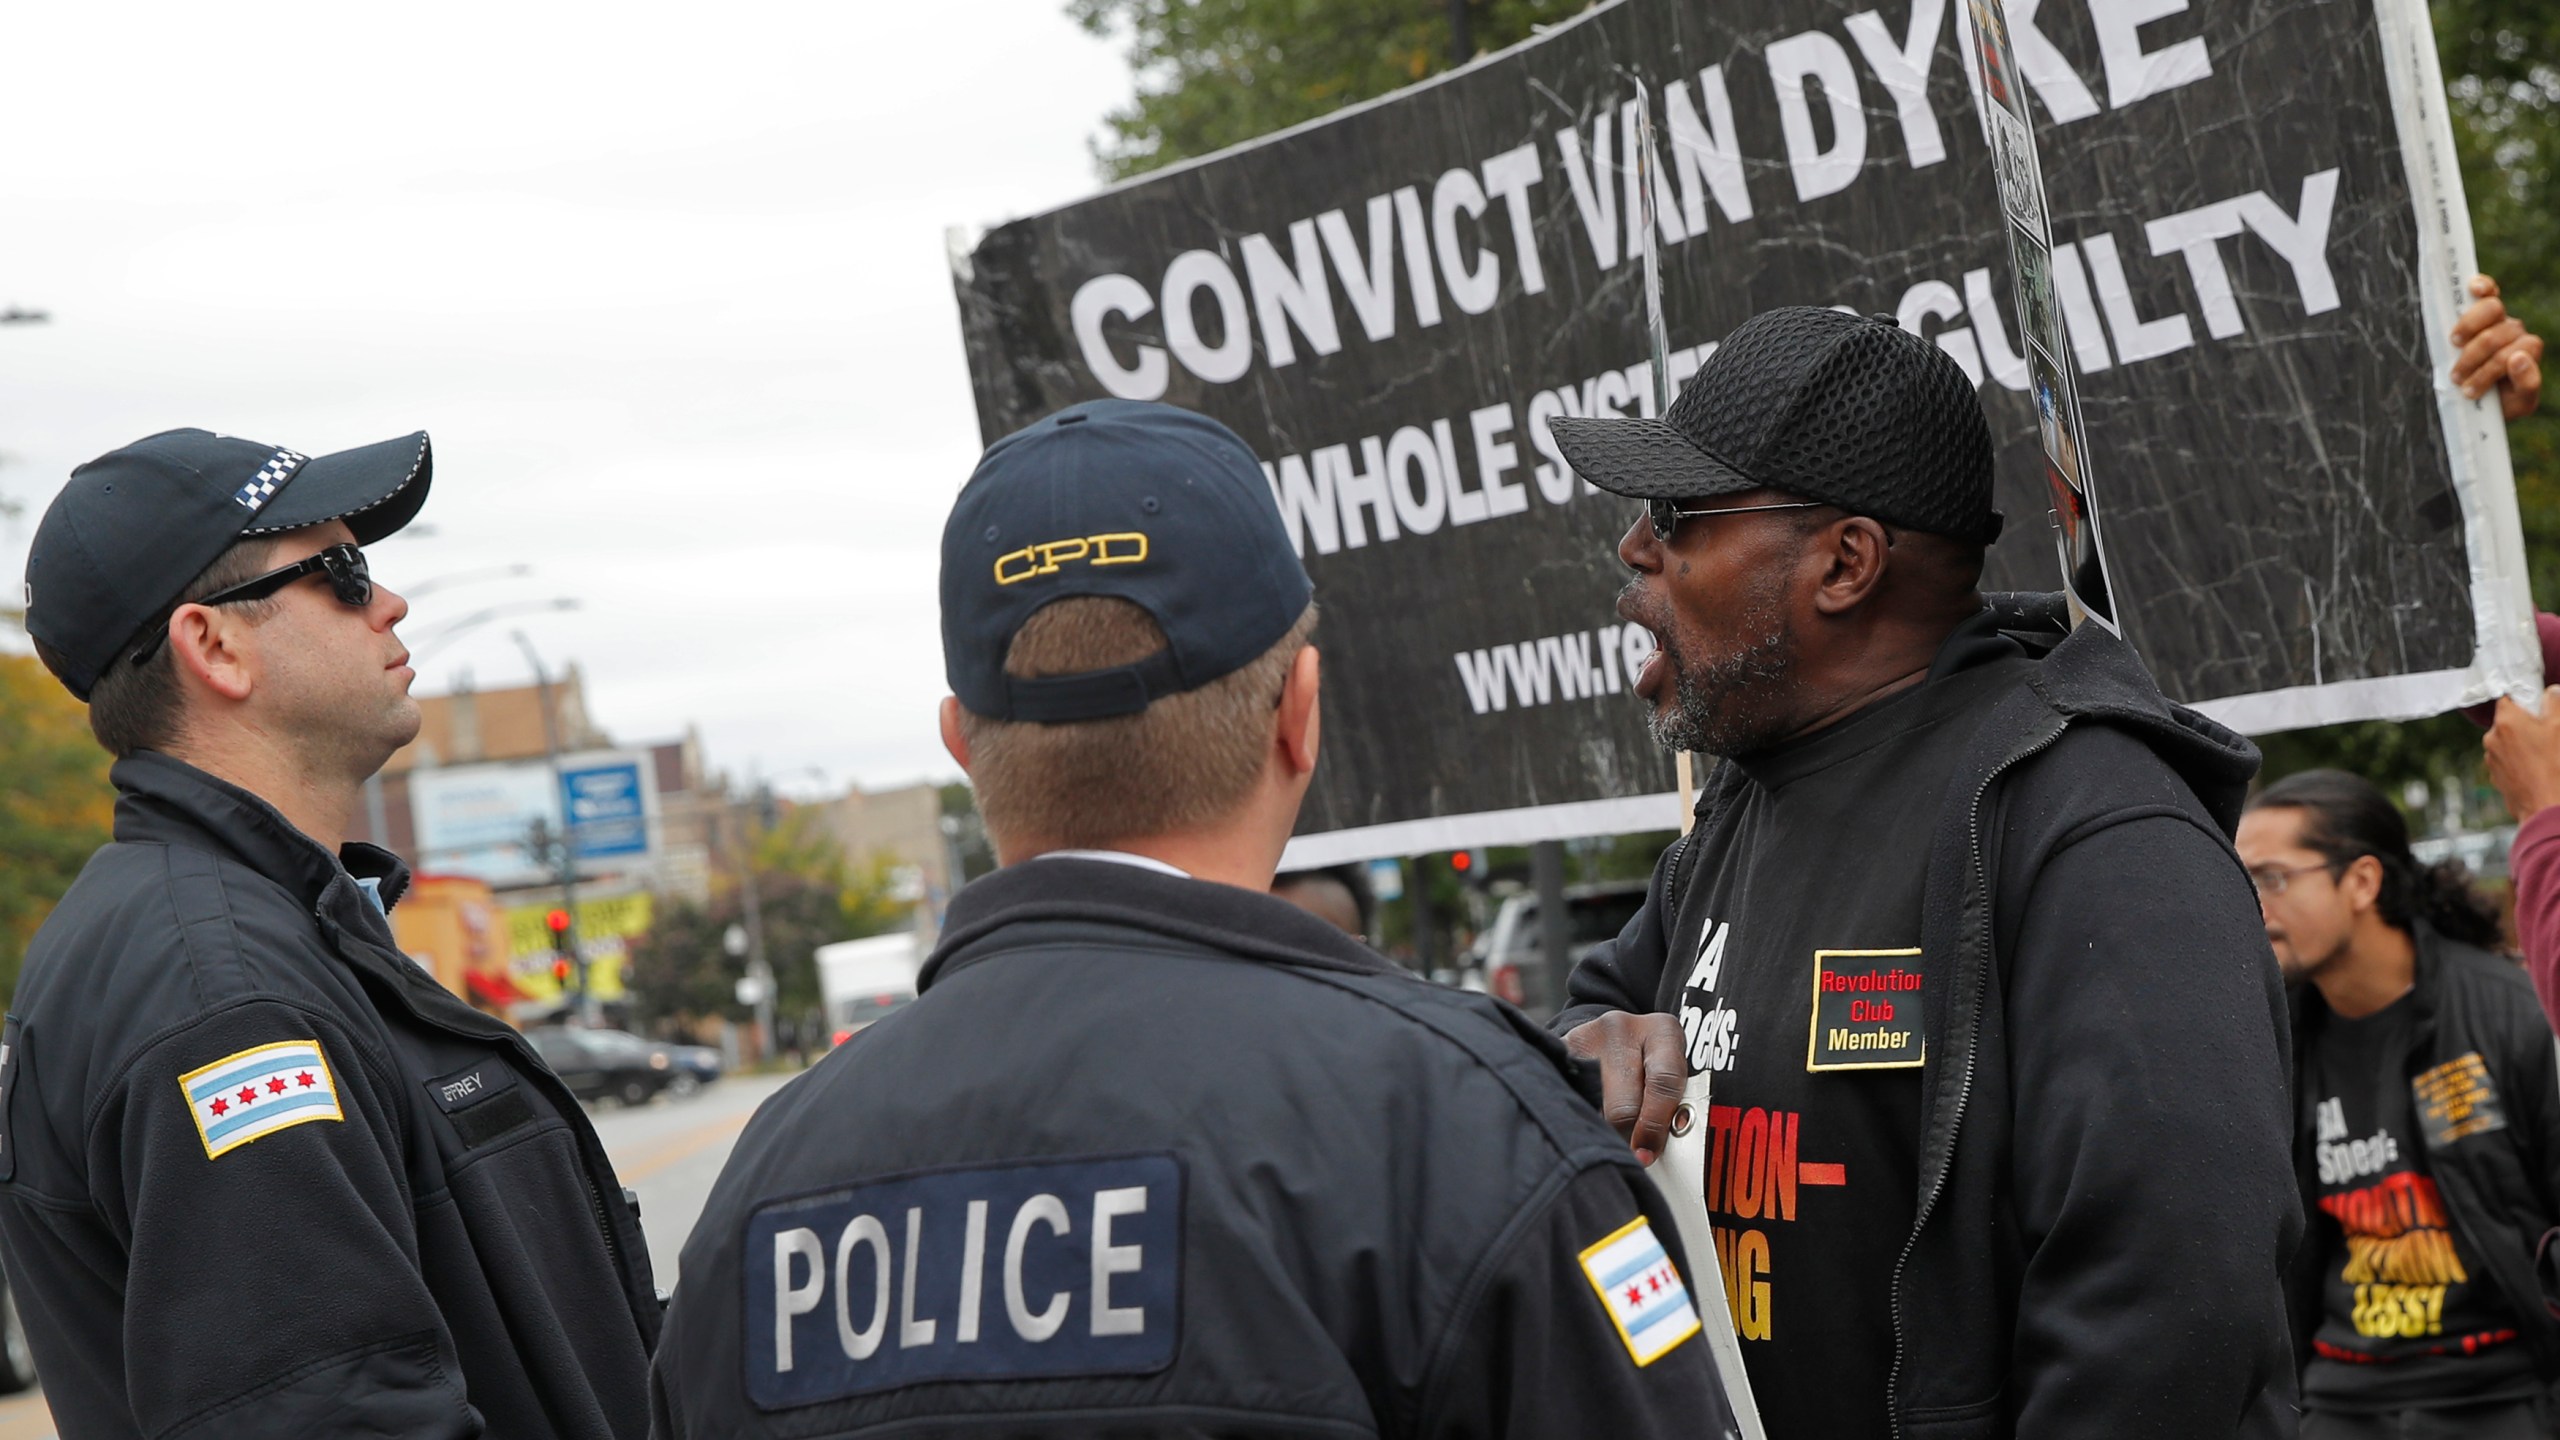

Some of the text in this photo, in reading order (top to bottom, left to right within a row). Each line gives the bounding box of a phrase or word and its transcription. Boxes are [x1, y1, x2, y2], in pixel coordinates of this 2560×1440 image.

[1070, 142, 1545, 401] CONVICT
[1556, 63, 1754, 271] VAN
[1764, 0, 2213, 203] DYKE
[1261, 402, 1528, 555] WHOLE
[1896, 167, 2341, 394] GUILTY
[994, 532, 1148, 585] CPD
[1828, 1026, 1911, 1051] Member
[1851, 1000, 1894, 1022] Club
[774, 1186, 1147, 1373] POLICE
